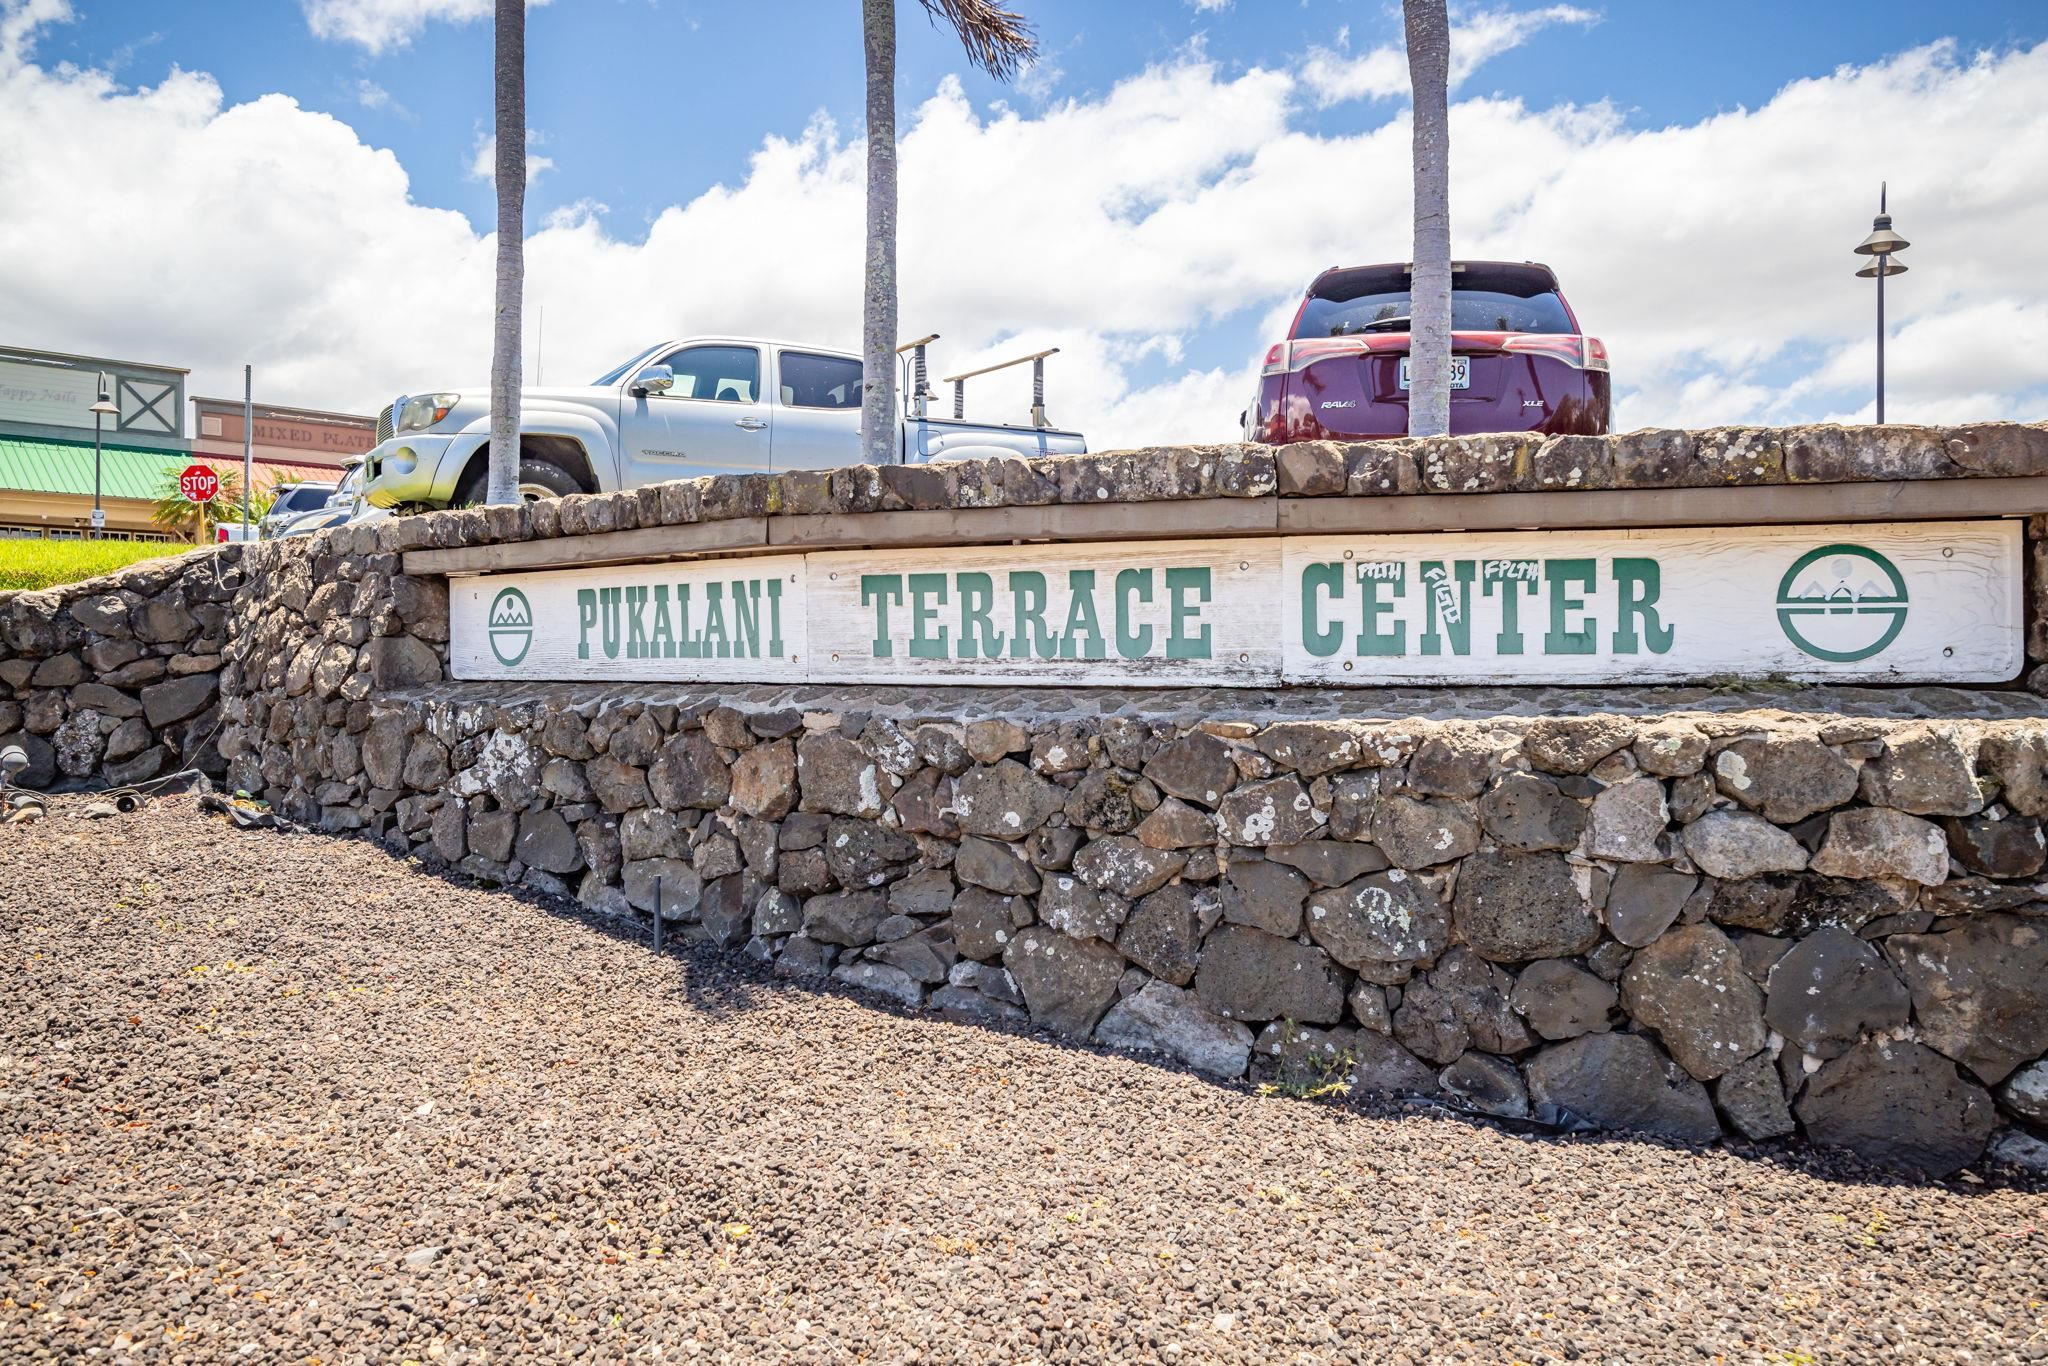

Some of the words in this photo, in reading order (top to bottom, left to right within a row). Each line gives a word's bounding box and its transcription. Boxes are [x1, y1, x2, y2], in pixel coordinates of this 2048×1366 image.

[41, 388, 77, 403] Nails
[1321, 400, 1356, 409] RAV4
[254, 426, 312, 442] MIXED
[183, 475, 216, 490] STOP
[578, 579, 784, 660] PUKALANI
[861, 567, 1212, 660] TERRACE
[1301, 558, 1675, 657] CENTER
